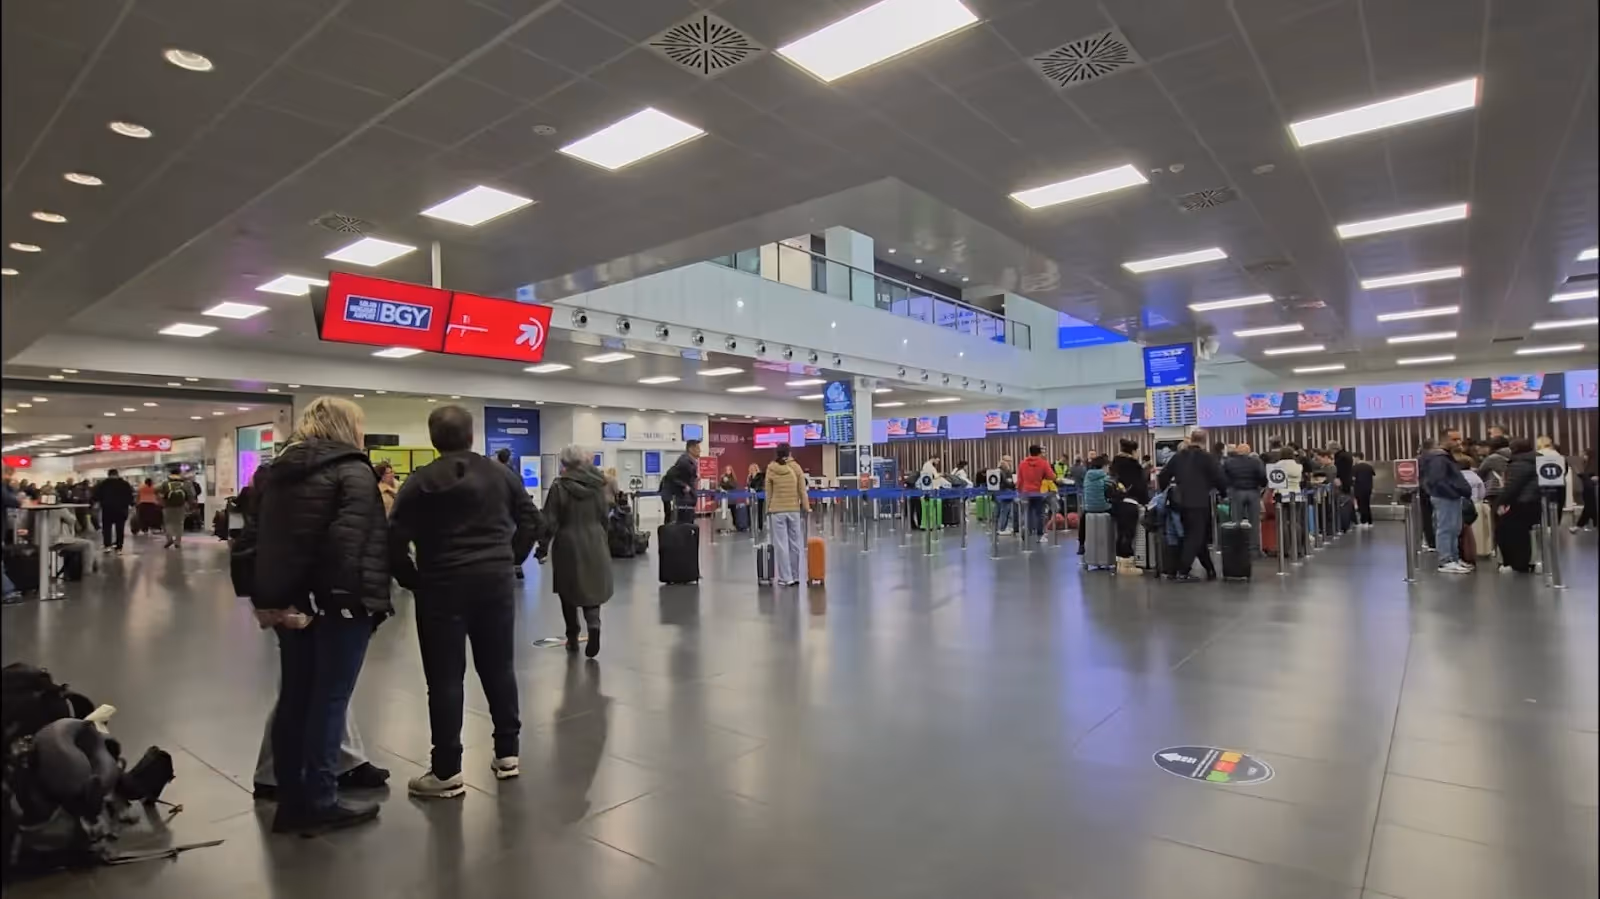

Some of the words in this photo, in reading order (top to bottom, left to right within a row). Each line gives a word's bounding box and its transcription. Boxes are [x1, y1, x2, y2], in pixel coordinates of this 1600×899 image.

[379, 302, 429, 327] BGY
[1544, 467, 1557, 476] 11
[1271, 472, 1284, 481] 10
